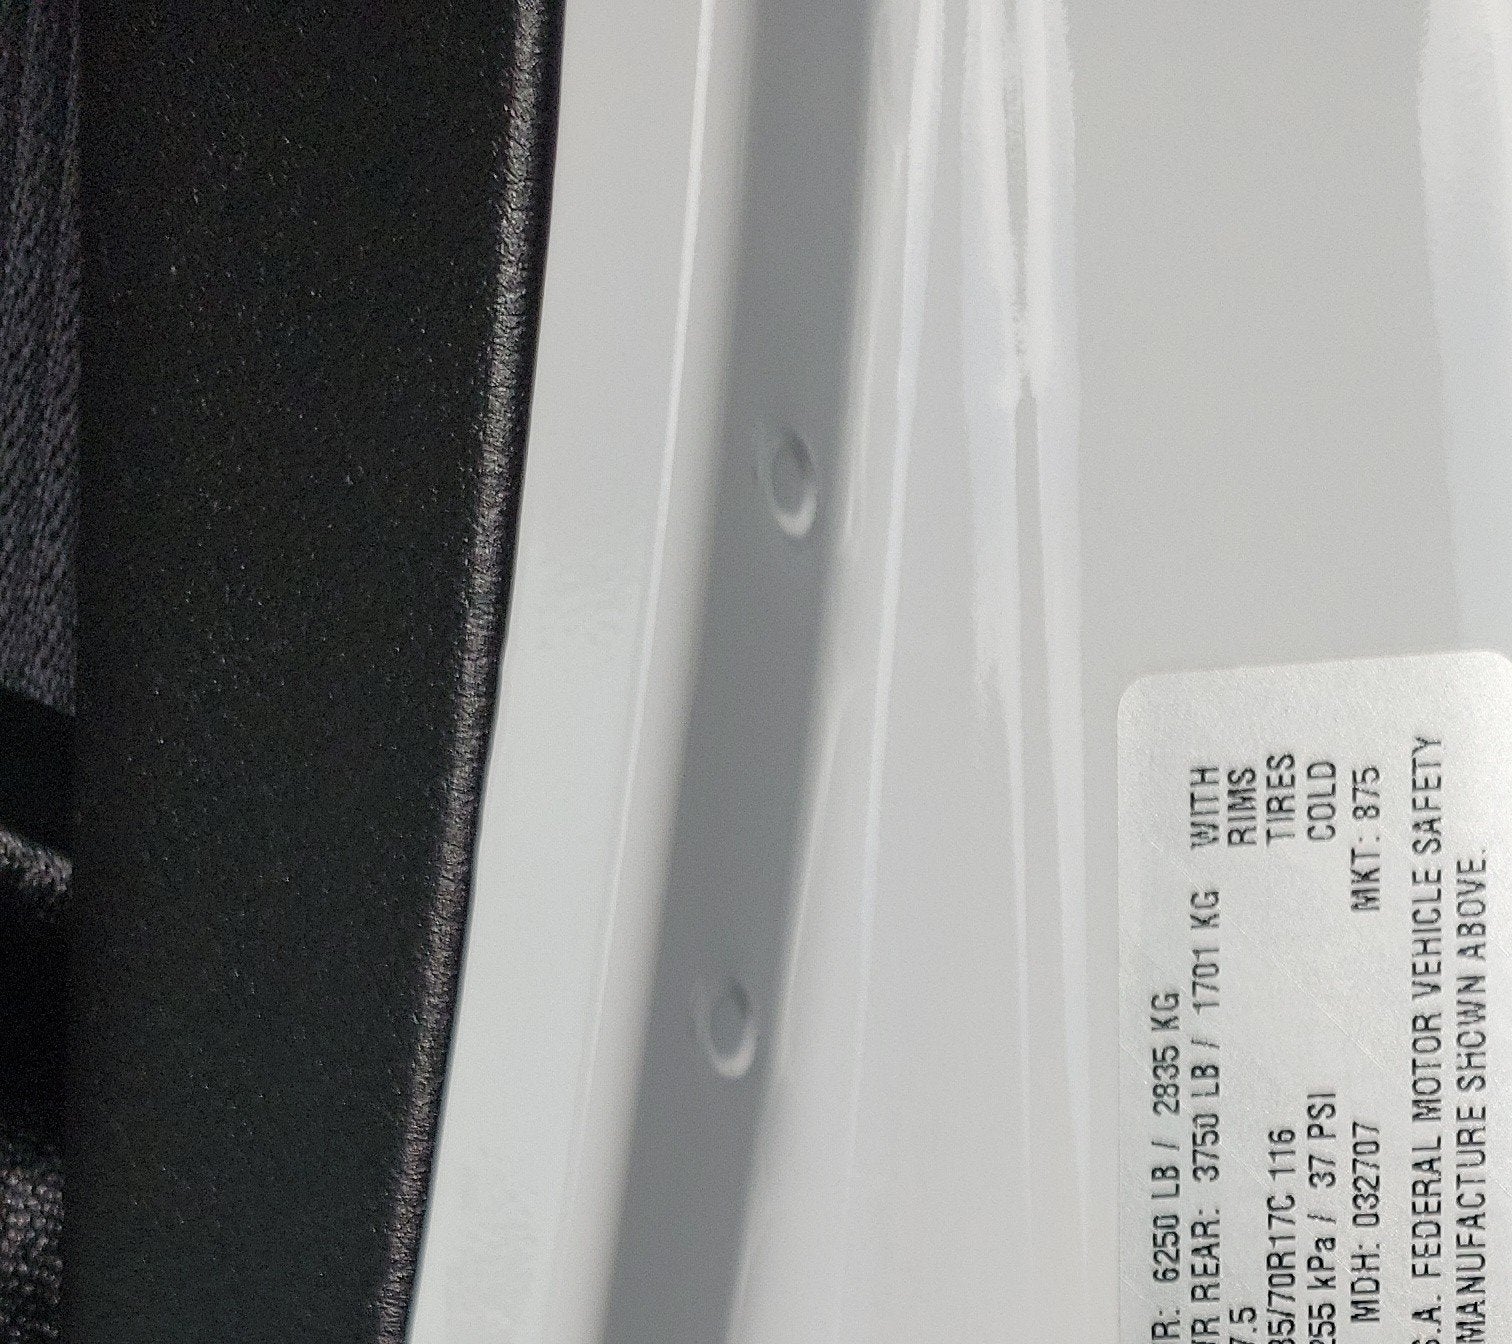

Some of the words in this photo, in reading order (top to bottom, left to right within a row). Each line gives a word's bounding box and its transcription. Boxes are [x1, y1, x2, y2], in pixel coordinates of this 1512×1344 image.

[1190, 767, 1219, 849] WITH
[1227, 767, 1256, 846] RIMS
[1266, 754, 1295, 845] TIRES
[1307, 761, 1336, 840] COLD
[1352, 766, 1380, 819] 875
[1412, 737, 1441, 854] SAFETY
[1351, 837, 1380, 910] MKT:
[1456, 848, 1486, 960] ABOVE.
[1190, 891, 1219, 929] KG
[1412, 869, 1441, 999] VEHICLE
[1150, 993, 1179, 1031] KG
[1192, 948, 1219, 1014] 1701
[1190, 1037, 1220, 1049] /
[1412, 1013, 1441, 1121] MOTOR
[1456, 975, 1486, 1091] SHOWN
[1152, 1045, 1179, 1115] 2835
[1191, 1064, 1219, 1097] LB
[1151, 1141, 1180, 1151] /
[1192, 1113, 1219, 1181] 3750
[1307, 1093, 1336, 1139] PSI
[1151, 1166, 1180, 1199] LB
[1268, 1129, 1295, 1180] 116
[1308, 1154, 1336, 1188] 37
[1352, 1121, 1380, 1227] 032707
[1307, 1213, 1336, 1223] /
[1412, 1136, 1441, 1277] FEDERAL
[1456, 1107, 1486, 1343] MANUFACTURE
[1153, 1214, 1180, 1282] 6250
[1191, 1210, 1219, 1302] REAR:
[1307, 1237, 1336, 1289] kPa
[1350, 1244, 1380, 1322] MDH:
